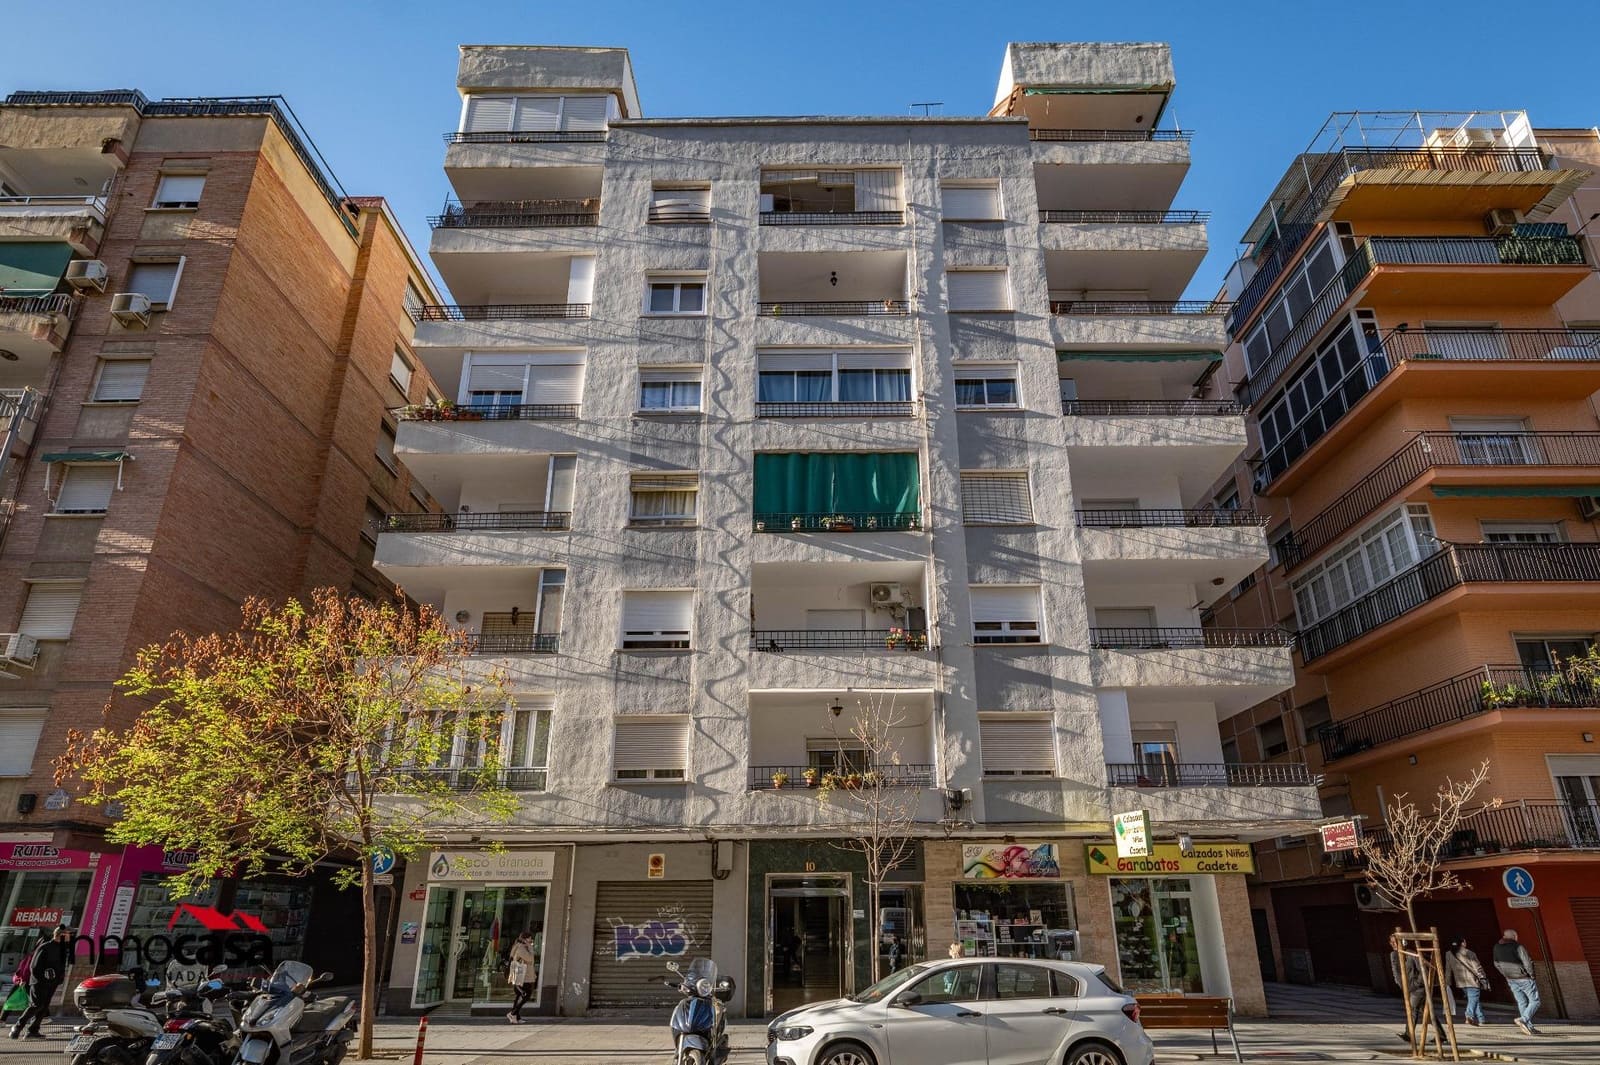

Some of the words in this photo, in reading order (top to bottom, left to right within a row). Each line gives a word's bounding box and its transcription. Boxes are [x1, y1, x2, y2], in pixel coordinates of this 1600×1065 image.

[1181, 849, 1223, 858] Calzados
[1225, 848, 1250, 858] Niños
[498, 857, 544, 868] Granada
[805, 861, 816, 872] 10
[1117, 858, 1180, 872] Garabatos
[1197, 861, 1239, 871] Cadete
[16, 911, 58, 922] REBAJAS
